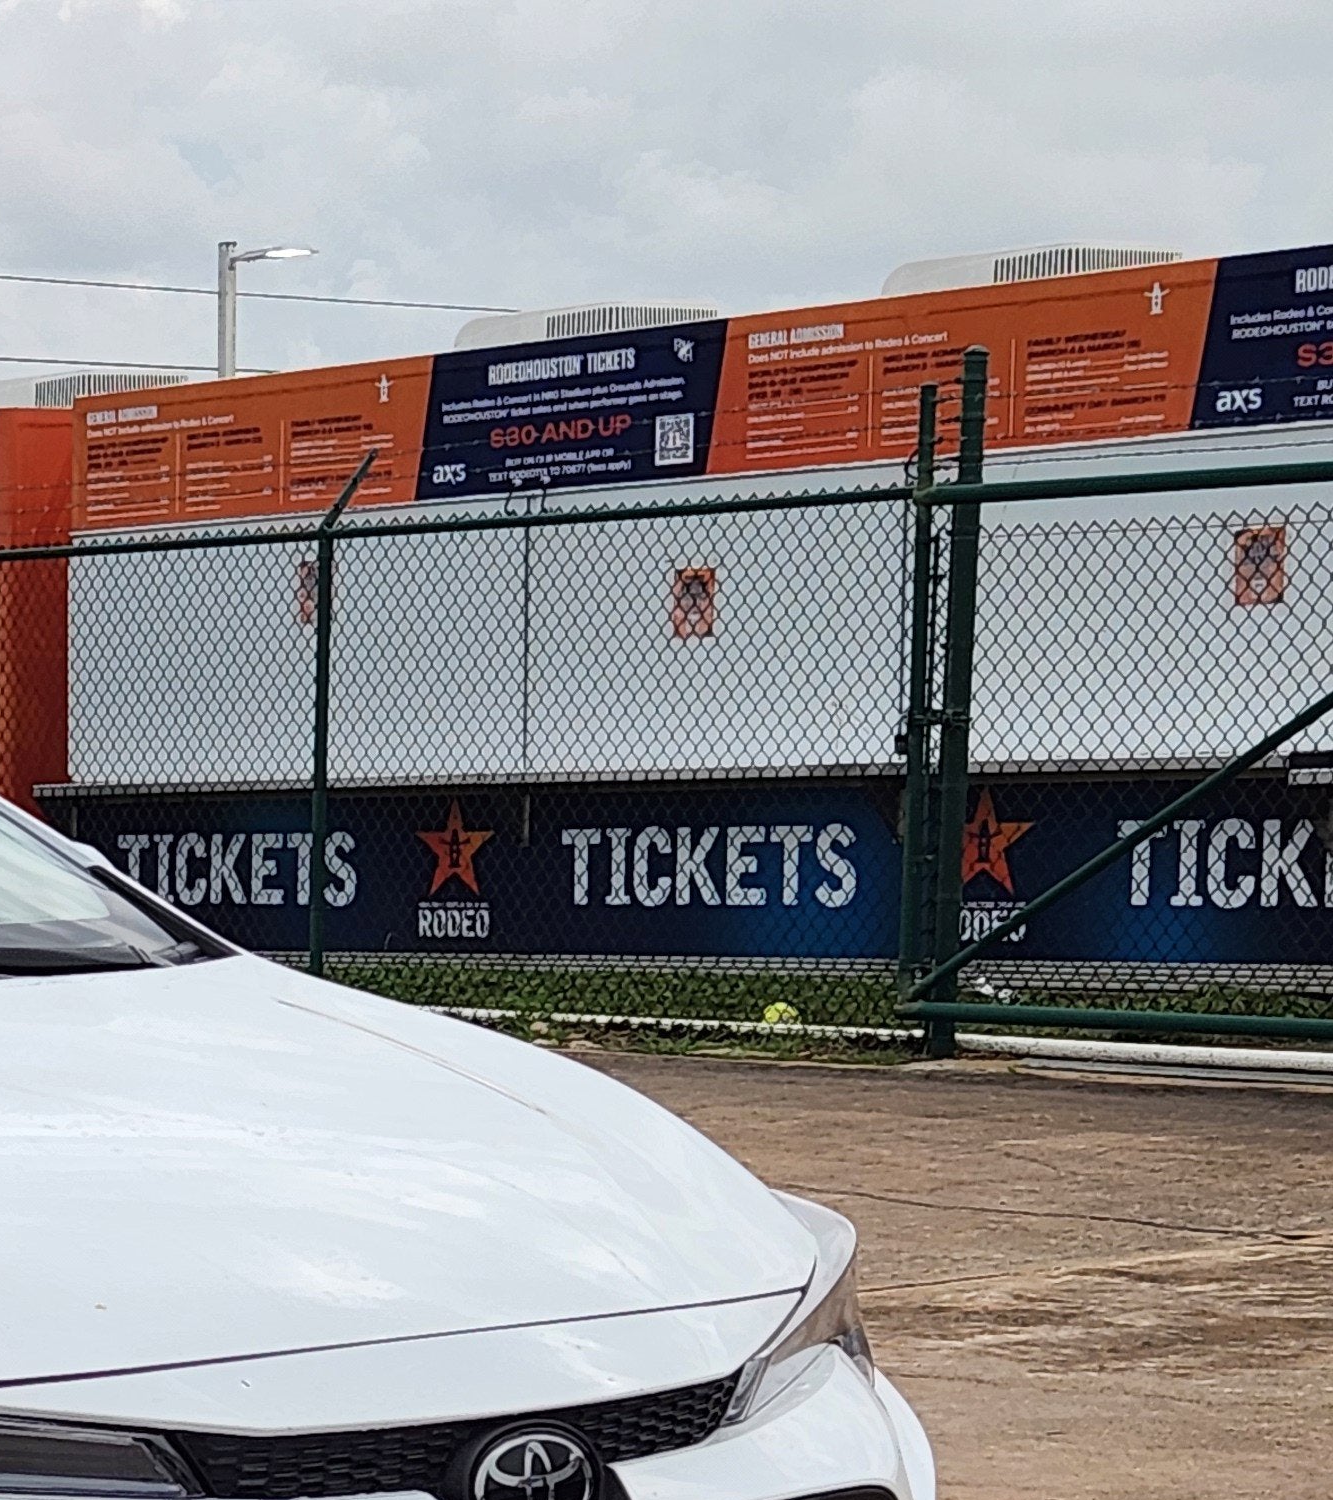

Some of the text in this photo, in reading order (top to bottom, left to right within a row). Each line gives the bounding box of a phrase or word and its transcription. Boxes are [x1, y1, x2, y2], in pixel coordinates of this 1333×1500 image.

[748, 328, 788, 349] GENERAL
[748, 352, 769, 364] Does
[770, 350, 788, 361] NOT
[911, 331, 947, 346] Concert
[587, 347, 635, 374] TICKETS
[1216, 387, 1263, 413] axs
[540, 417, 593, 444] AND
[598, 414, 631, 437] UP
[432, 463, 467, 485] axs
[117, 831, 357, 906] TICKETS
[561, 823, 858, 907] TICKETS
[418, 909, 490, 938] RODEO
